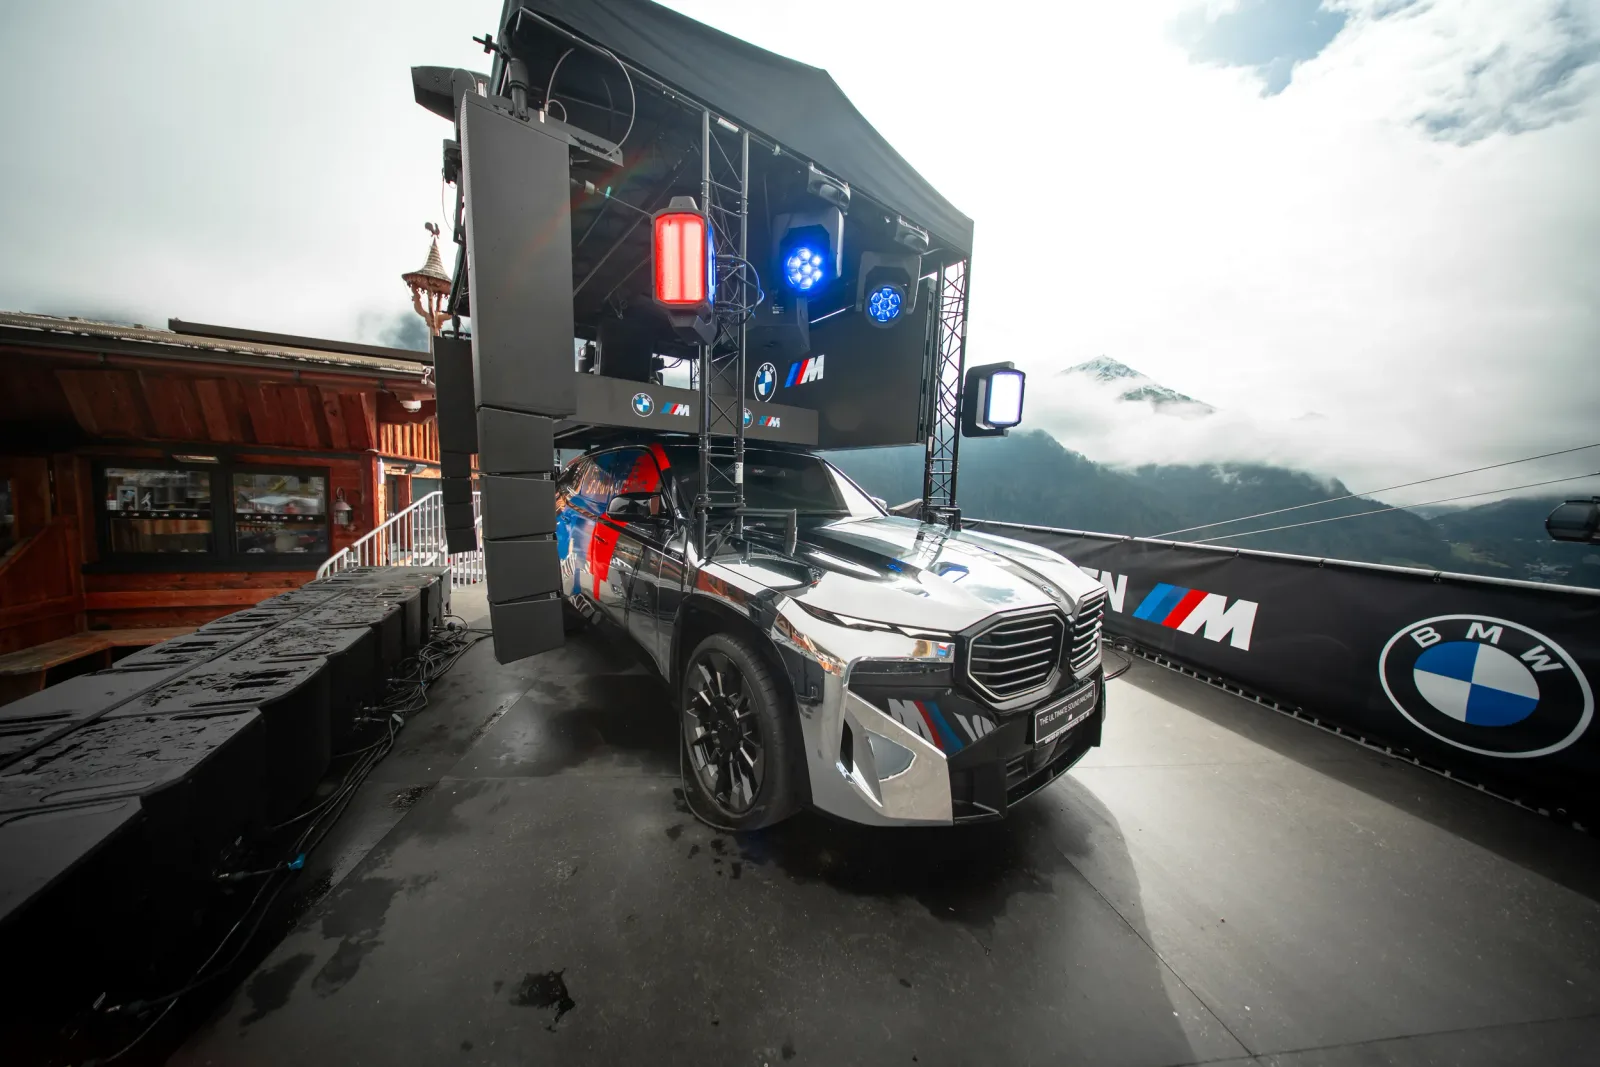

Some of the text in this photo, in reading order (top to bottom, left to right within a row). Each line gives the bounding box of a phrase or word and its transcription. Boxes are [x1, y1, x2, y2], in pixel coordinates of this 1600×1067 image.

[1177, 592, 1258, 651] M
[1410, 622, 1564, 673] BMW
[1039, 716, 1049, 727] THE
[1048, 706, 1068, 722] ULTIMATE
[1067, 699, 1080, 712] SOUND
